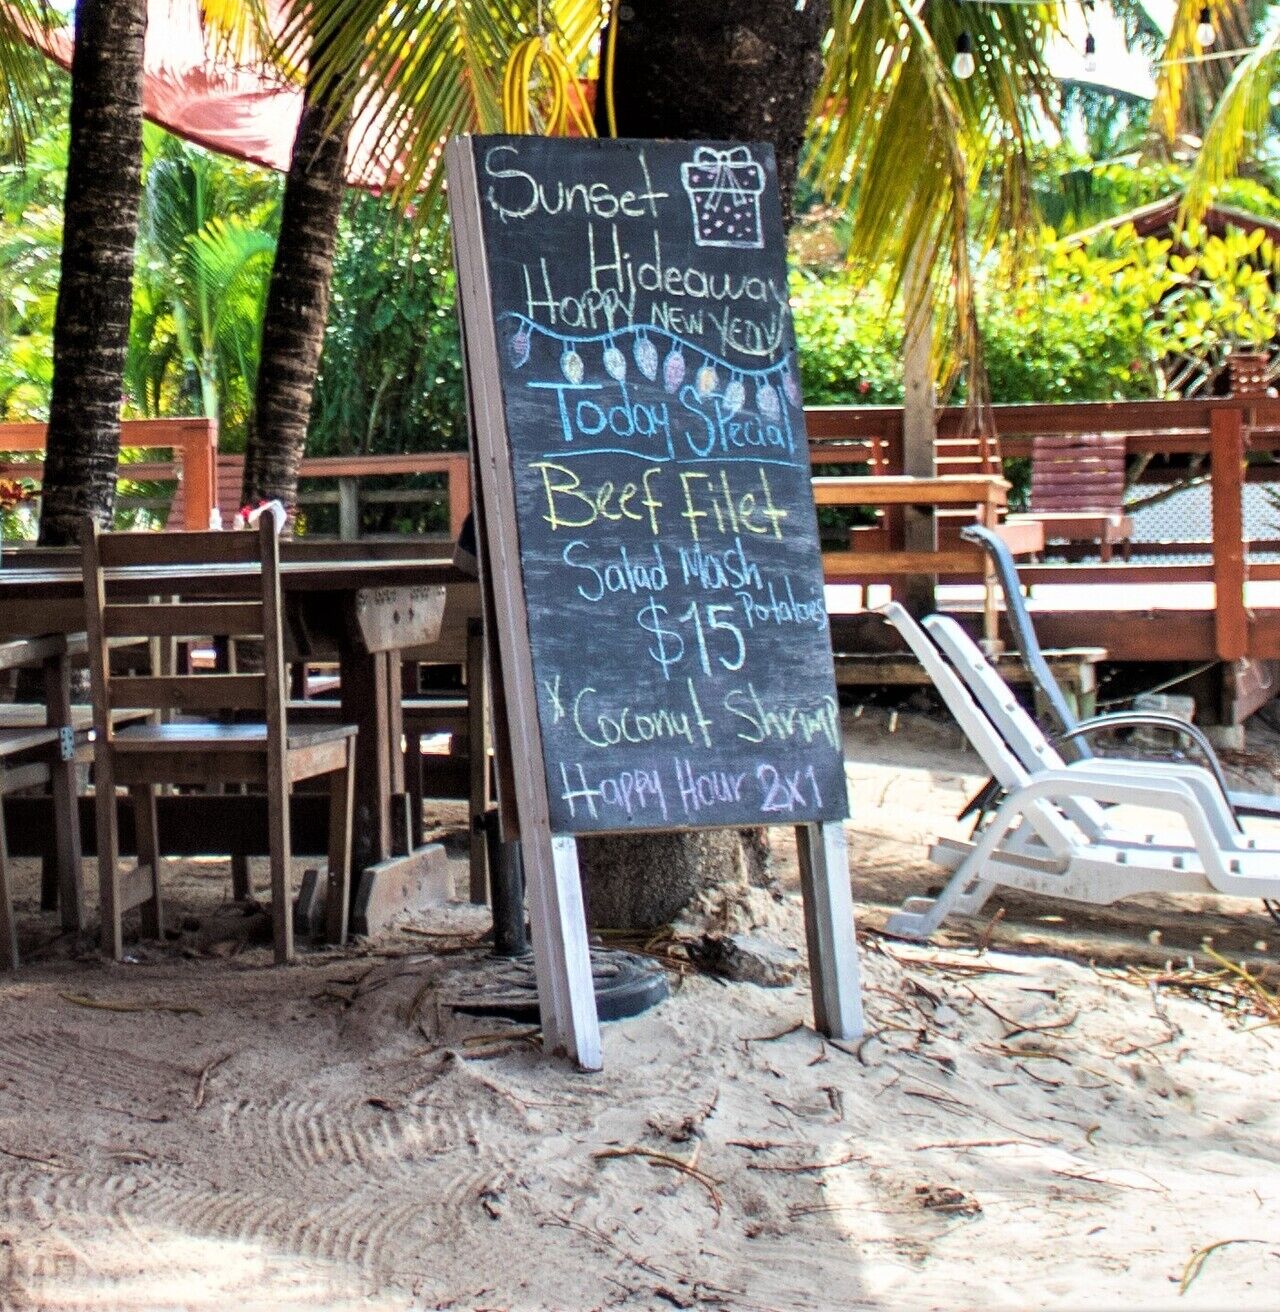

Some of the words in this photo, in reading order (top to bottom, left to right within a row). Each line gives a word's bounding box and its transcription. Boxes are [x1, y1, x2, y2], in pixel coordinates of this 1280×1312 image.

[485, 145, 669, 223] Sunset
[587, 222, 789, 338] Hideaway
[527, 382, 675, 460] Today
[679, 384, 795, 457] Special
[529, 463, 662, 535] Beef
[679, 468, 788, 544] Filet
[563, 540, 669, 602] Salad
[678, 536, 764, 590] Mash
[637, 596, 746, 681] $15
[573, 677, 713, 749] Coconut
[724, 682, 841, 751] Shrimp
[560, 761, 669, 821] Happy
[675, 756, 744, 815] Hour
